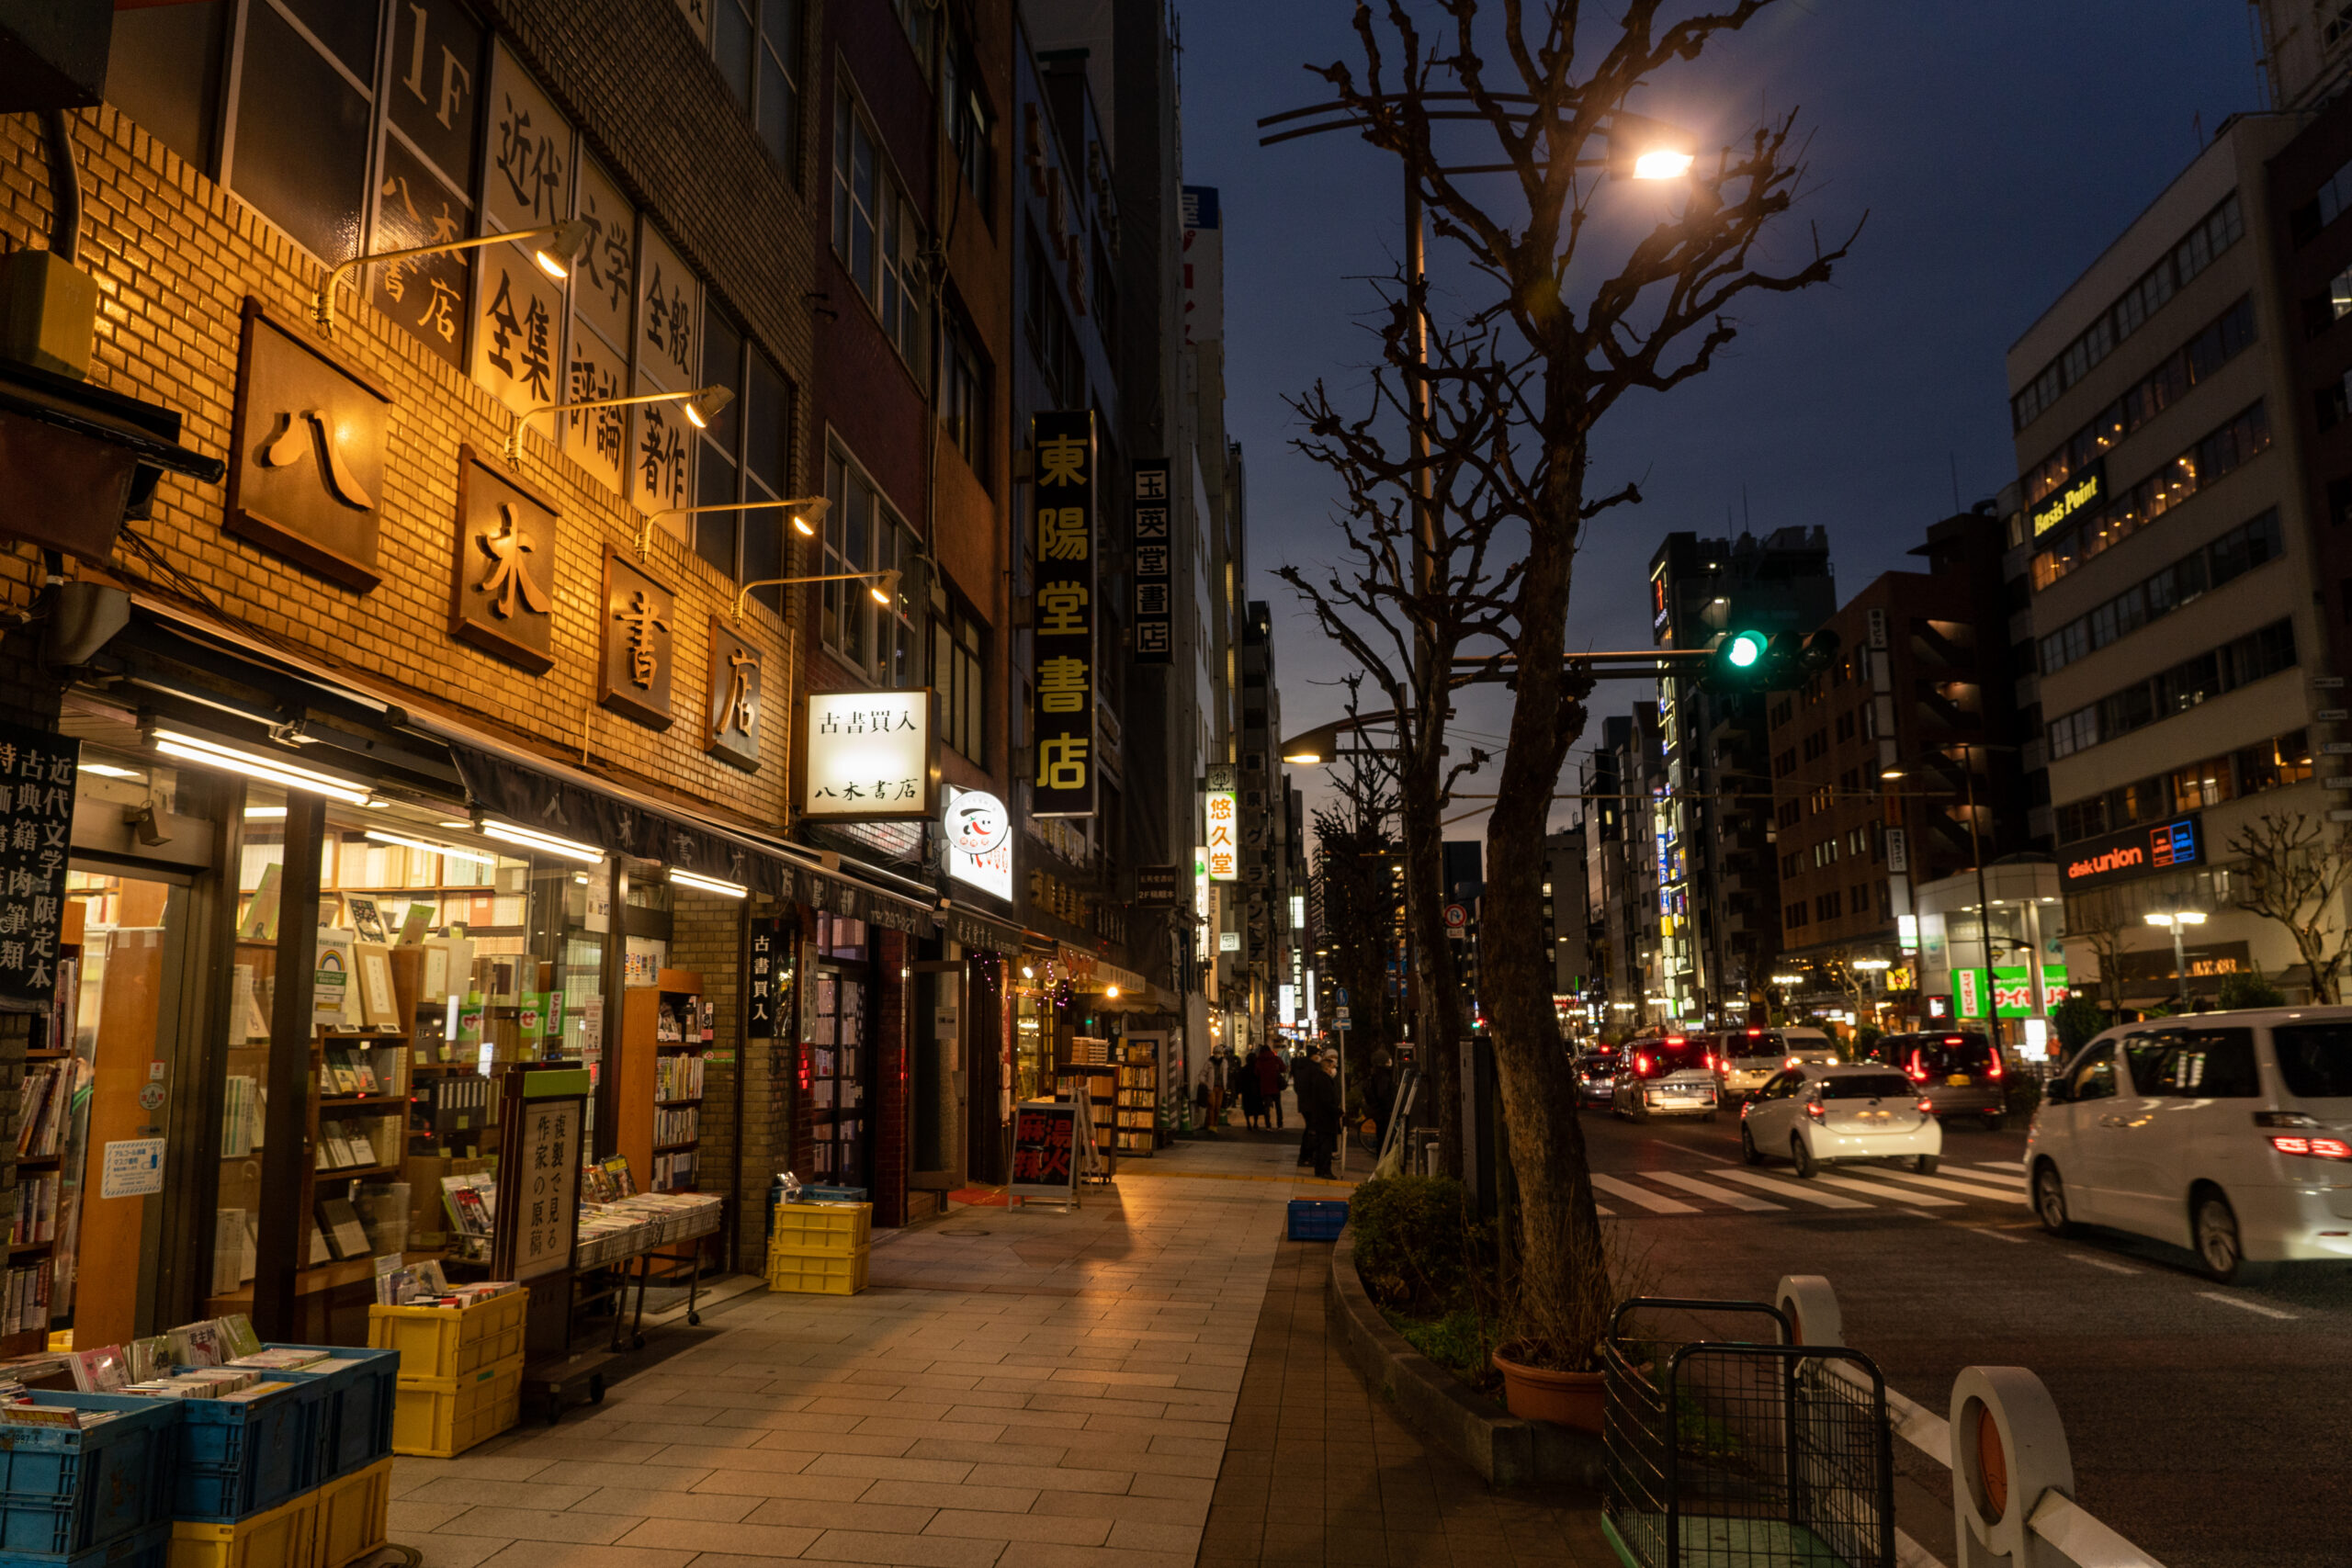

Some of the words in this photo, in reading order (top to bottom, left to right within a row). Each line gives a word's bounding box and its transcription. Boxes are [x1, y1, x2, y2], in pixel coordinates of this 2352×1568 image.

[402, 2, 470, 130] 1F
[2033, 501, 2064, 537] Basis
[2064, 475, 2098, 515] Point
[1136, 470, 1169, 654] 玉英堂書店
[1036, 433, 1090, 791] 東陽堂書店
[817, 709, 918, 735] 古書買入
[814, 778, 919, 802] 八木書店
[1210, 796, 1233, 874] 悠久堂
[752, 934, 772, 1021] 古書買入
[529, 1115, 550, 1257] 作家の原稿
